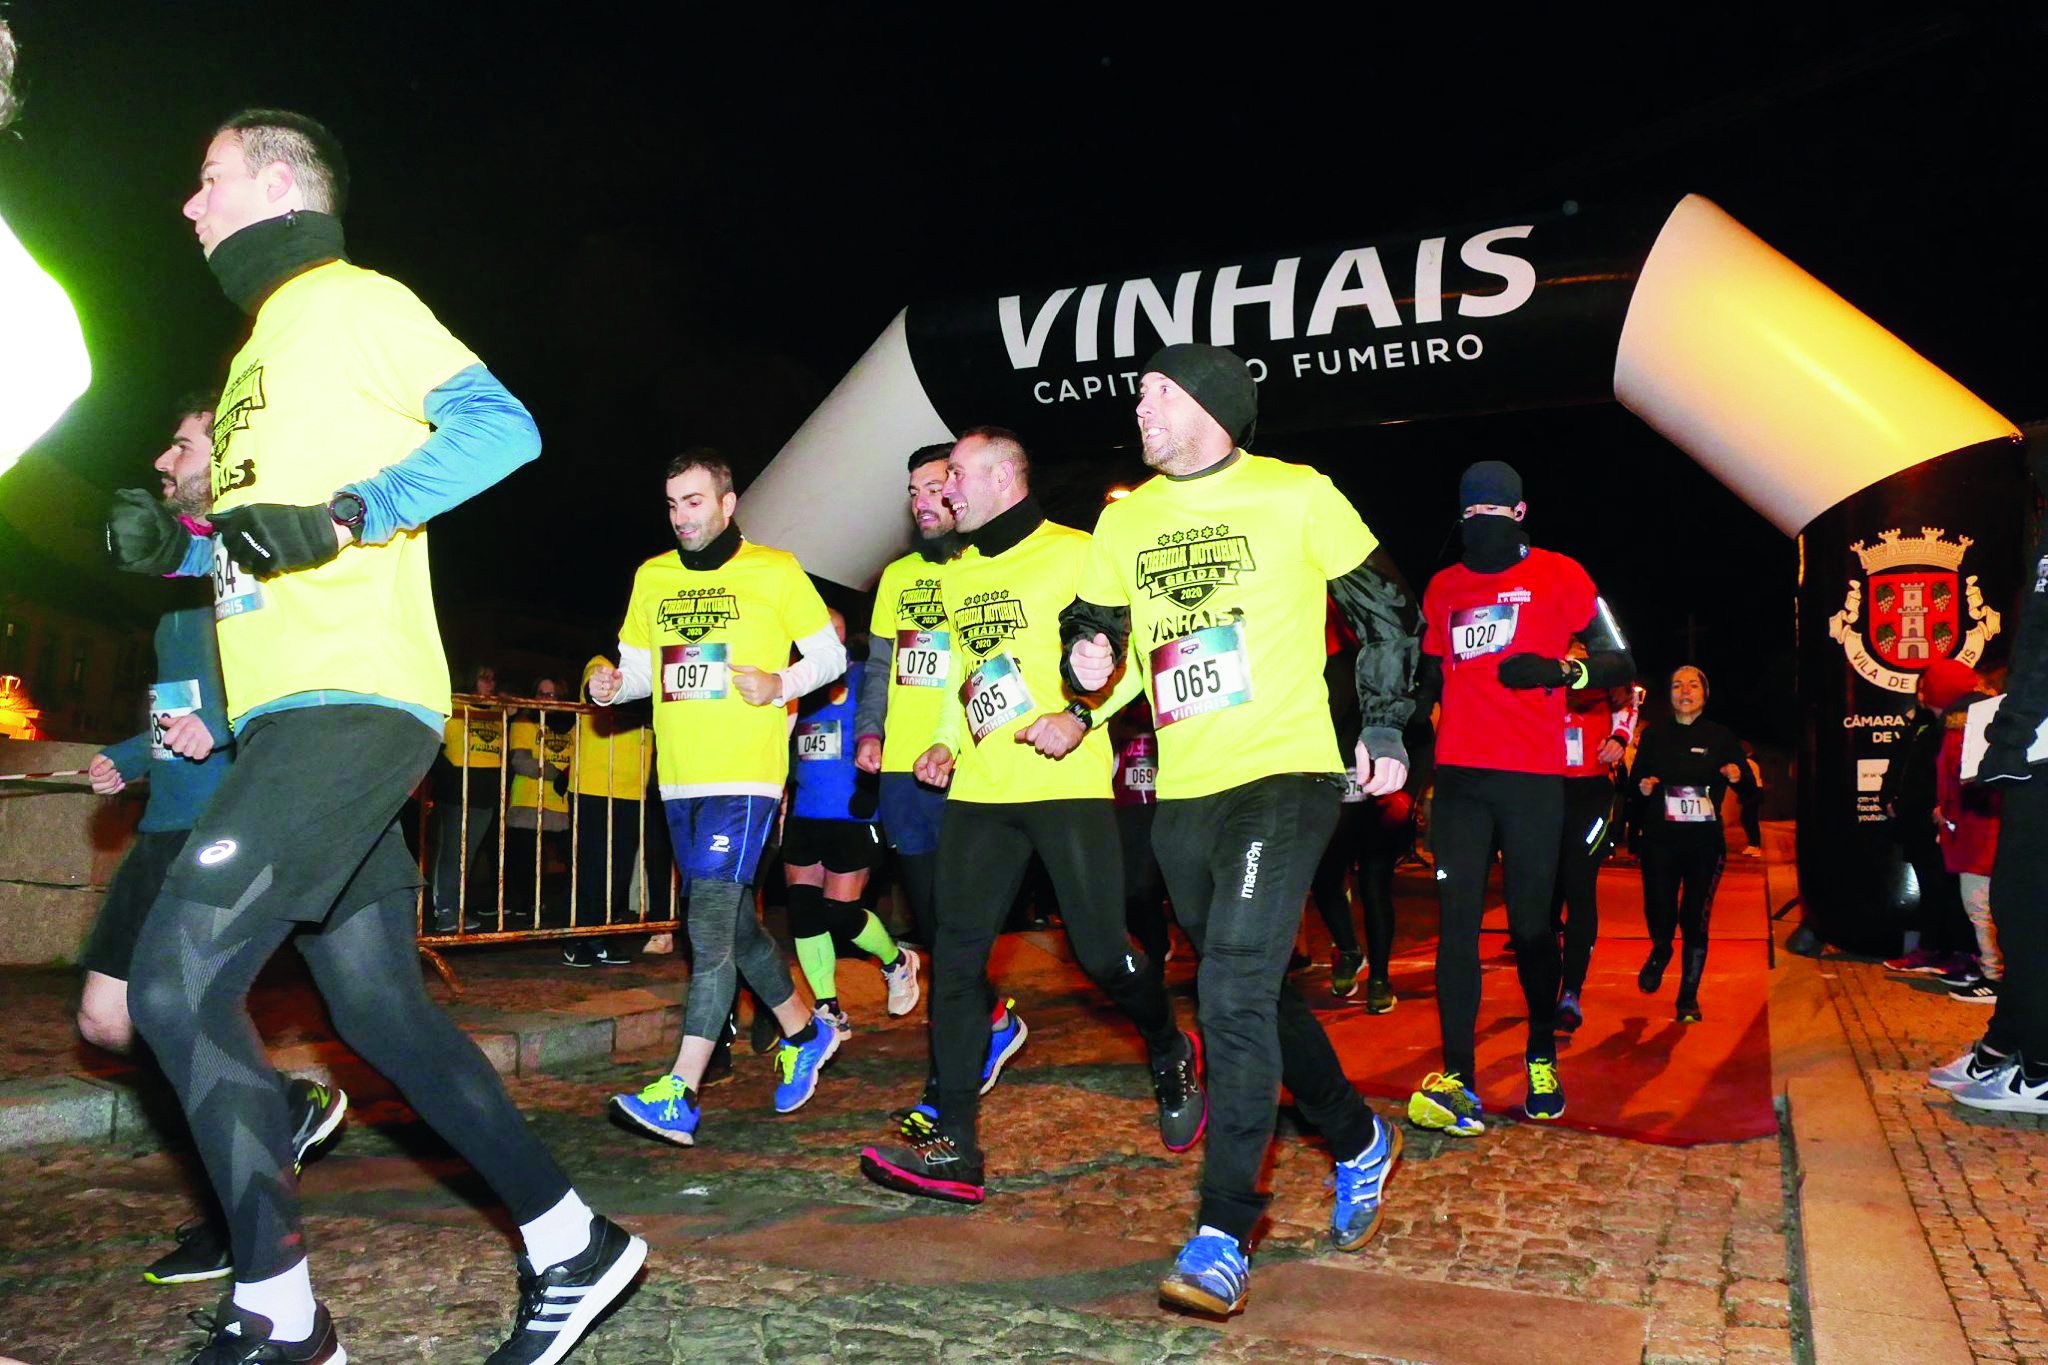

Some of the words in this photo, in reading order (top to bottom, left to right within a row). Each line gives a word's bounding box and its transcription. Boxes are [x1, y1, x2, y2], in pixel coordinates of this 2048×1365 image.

[998, 225, 1537, 370] VINHAIS
[1034, 371, 1139, 404] CAPIT
[1293, 333, 1483, 378] FUMEIRO
[1137, 546, 1188, 587] CORRIDA
[1190, 537, 1254, 571] NOTURNA
[214, 553, 236, 598] 84
[1165, 568, 1220, 586] GEADA
[1180, 587, 1203, 600] 2020
[914, 605, 943, 614] GEAD
[676, 616, 716, 625] GEADA
[921, 616, 938, 625] 2020
[687, 627, 703, 636] 2020
[967, 625, 1004, 638] GEADA
[1466, 624, 1497, 649] 020
[975, 638, 992, 649] 2020
[907, 650, 938, 675] 078
[1853, 650, 1879, 680] VILA
[1888, 676, 1909, 689] DE
[677, 664, 708, 689] 097
[901, 676, 939, 687] VINHAIS
[1174, 659, 1221, 703] 065
[672, 691, 712, 700] VINHAIS
[972, 683, 1007, 724] 085
[1171, 695, 1230, 721] VINHAIS
[977, 708, 1018, 740] VINHAIS
[1843, 714, 1905, 728] CÂMARA
[804, 735, 826, 753] 045
[1872, 731, 1892, 743] DE
[1132, 769, 1153, 784] 069
[1681, 800, 1701, 814] 071
[1241, 841, 1263, 899] macron
